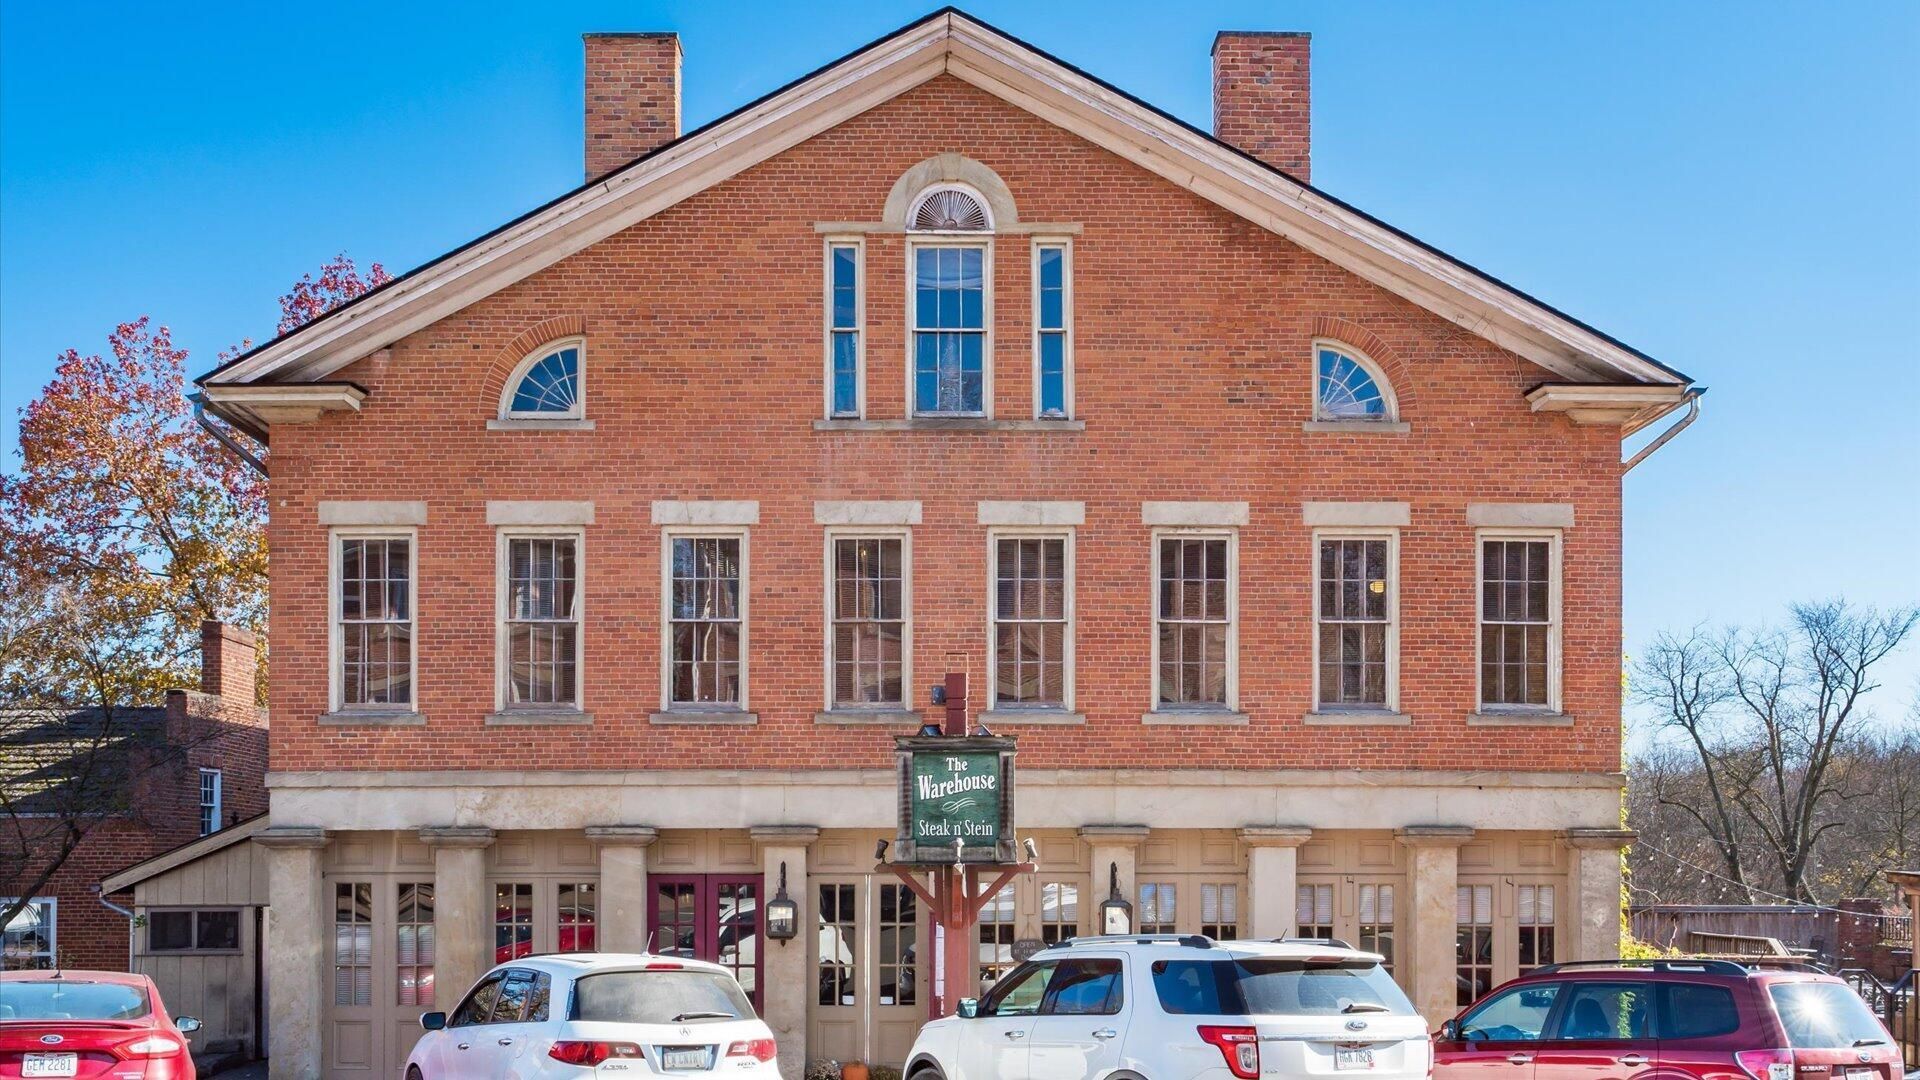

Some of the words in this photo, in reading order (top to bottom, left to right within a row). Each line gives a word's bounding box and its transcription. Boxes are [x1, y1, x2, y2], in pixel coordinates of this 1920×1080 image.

[946, 757, 968, 772] The
[918, 772, 996, 800] Warehouse
[919, 819, 951, 836] Steak
[964, 819, 993, 836] Stein
[47, 1058, 71, 1071] 2281
